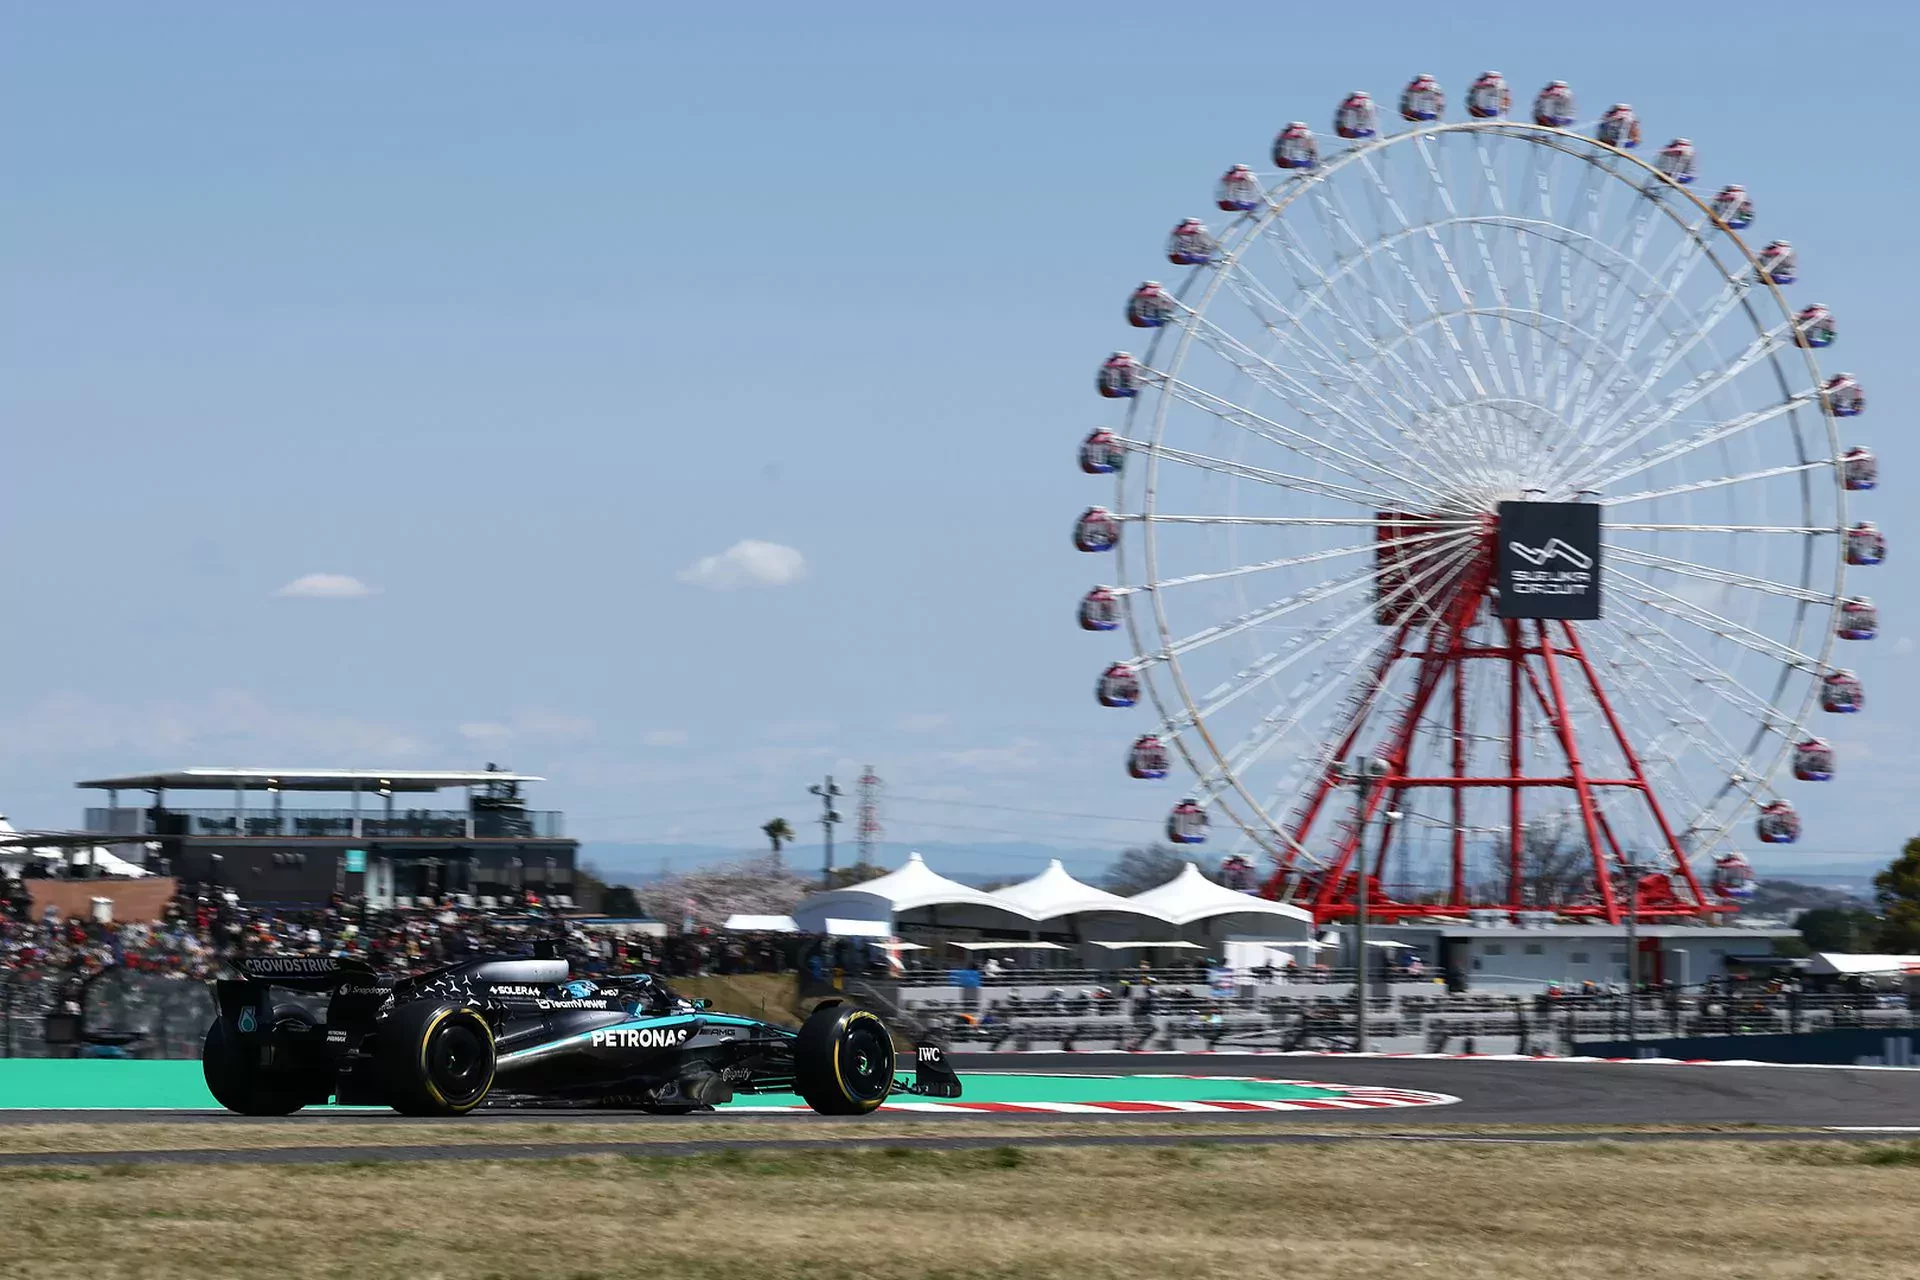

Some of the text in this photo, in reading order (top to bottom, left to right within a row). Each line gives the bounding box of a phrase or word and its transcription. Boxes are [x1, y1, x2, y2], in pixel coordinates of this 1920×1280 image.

[245, 958, 341, 973] CROWDSTRIKE
[352, 985, 392, 996] Snapdragon
[500, 985, 536, 996] SOLERA
[550, 999, 608, 1010] TeamViewer
[710, 1028, 736, 1036] AMG
[590, 1029, 688, 1048] PETRONAS
[918, 1047, 940, 1061] IWC
